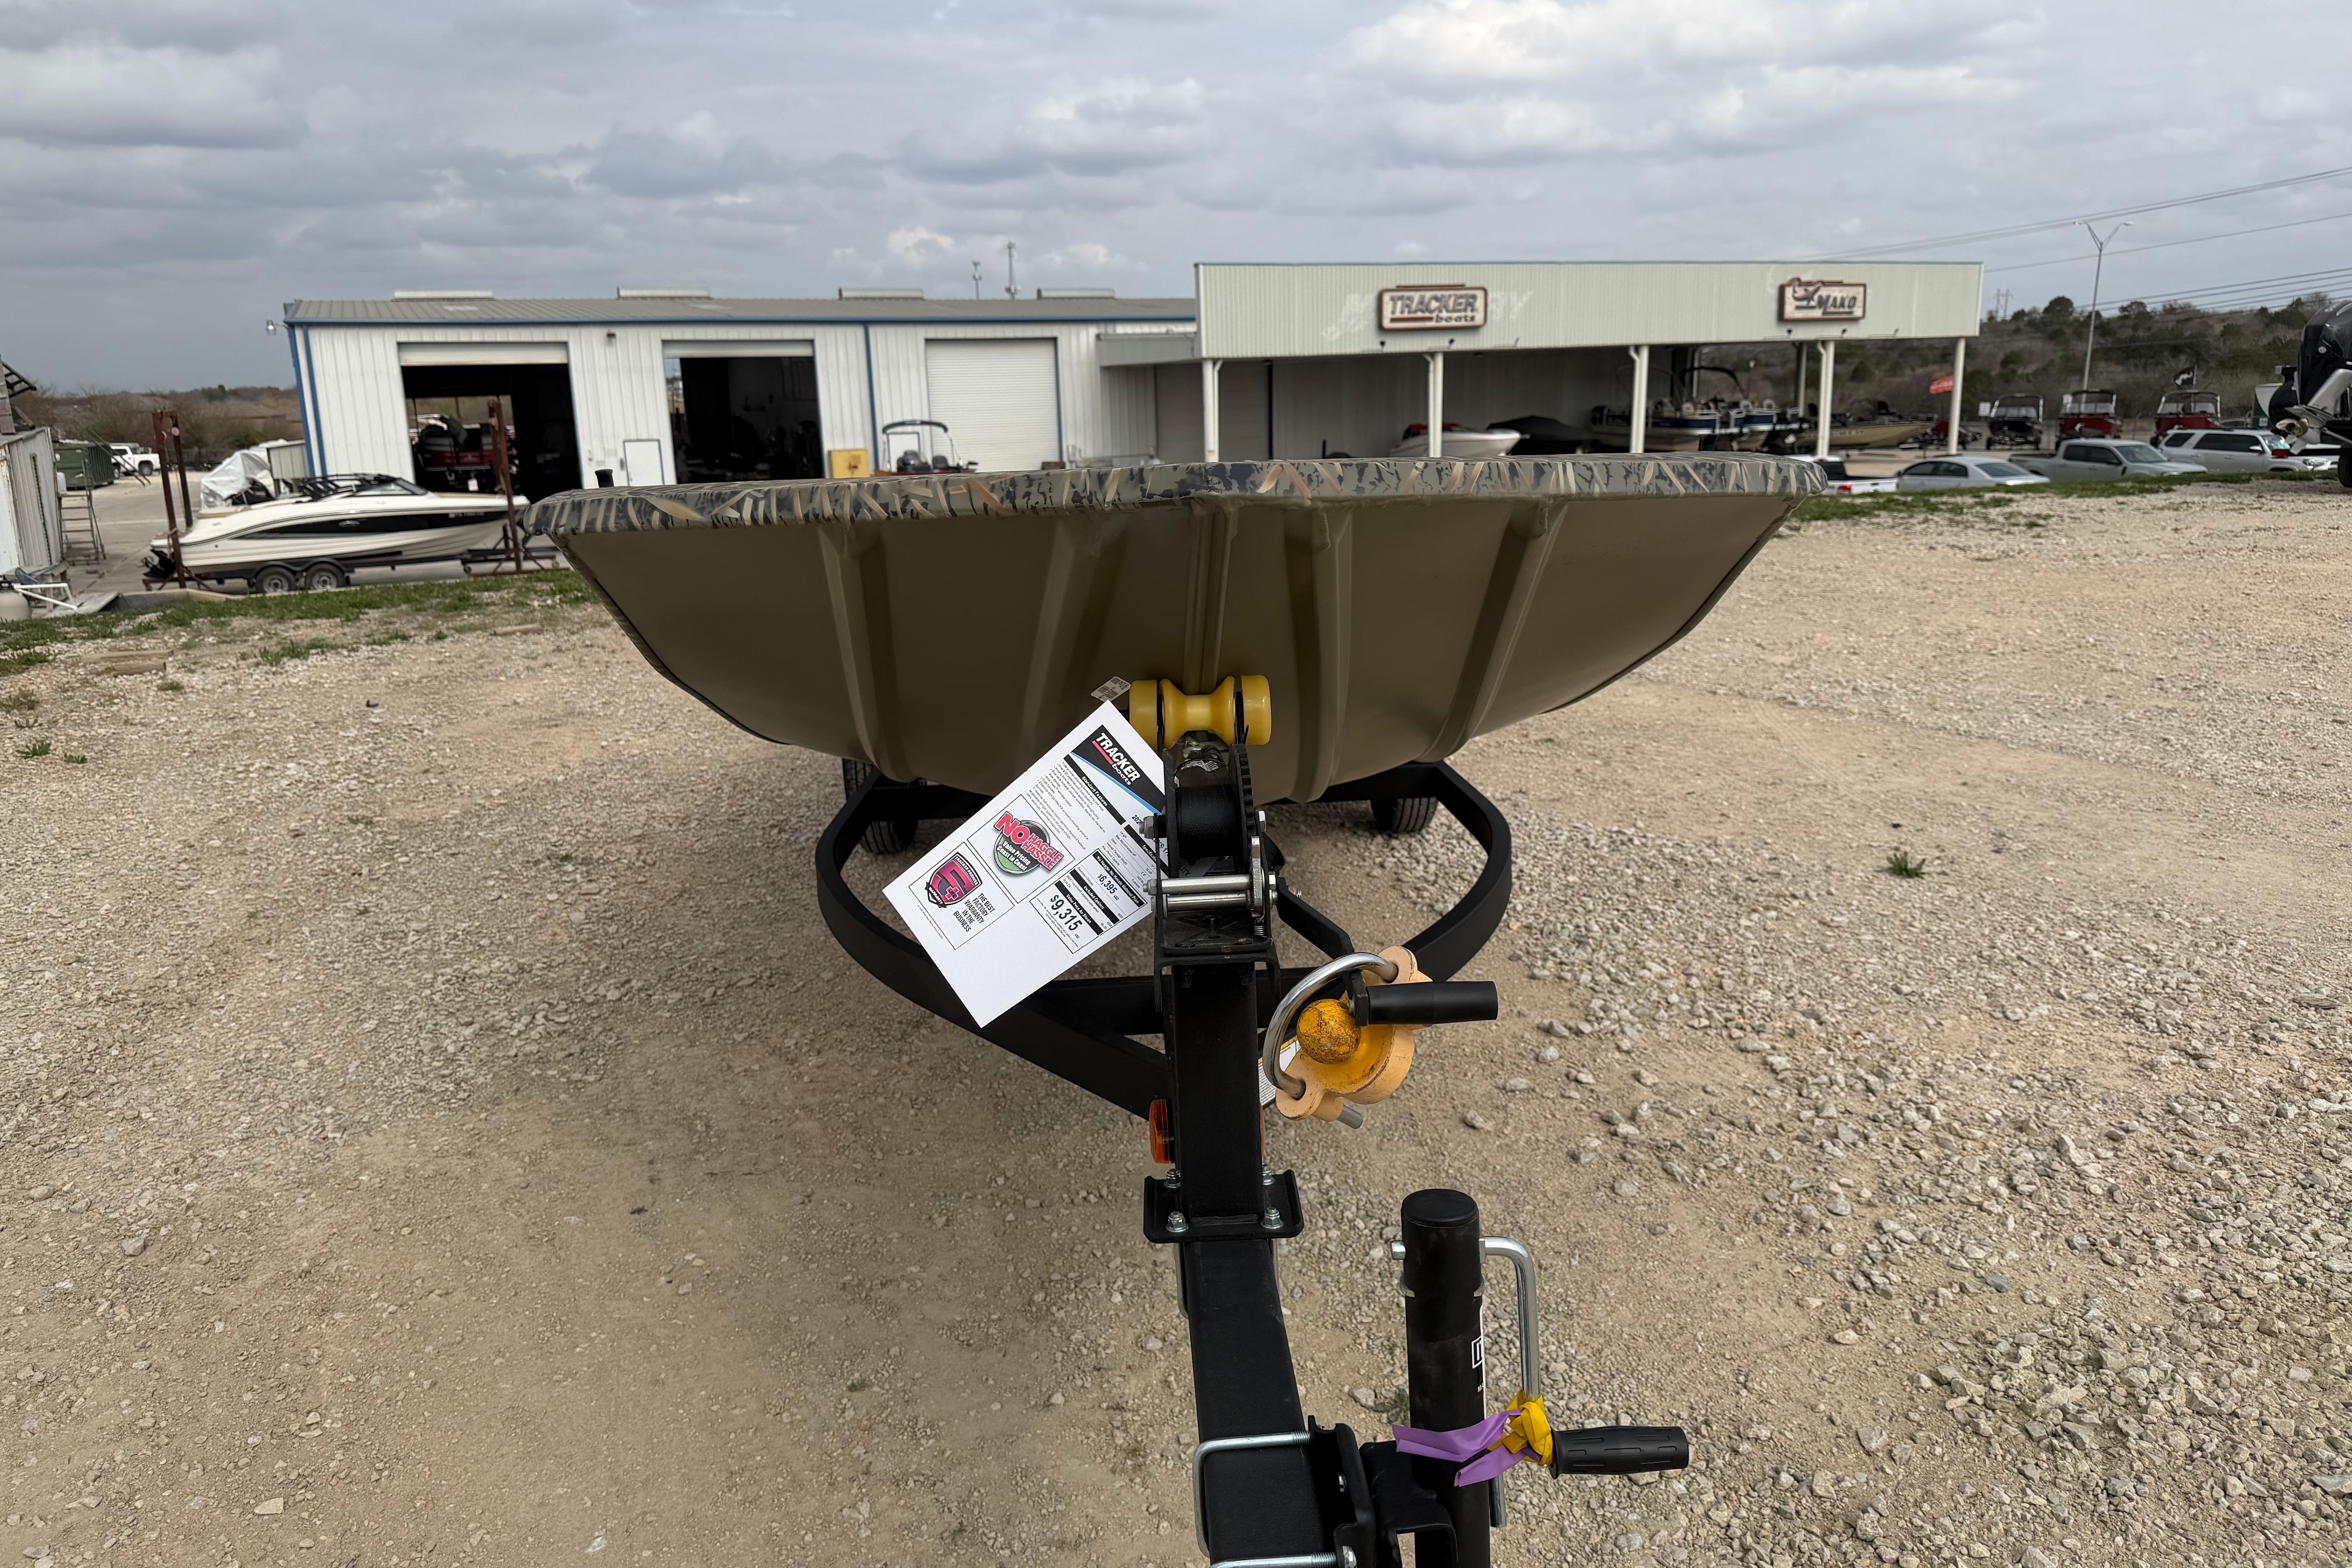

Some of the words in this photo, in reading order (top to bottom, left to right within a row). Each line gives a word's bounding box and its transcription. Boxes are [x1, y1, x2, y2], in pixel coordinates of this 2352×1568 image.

[1390, 294, 1477, 315] TRACKER
[1816, 294, 1857, 316] MAKO
[1435, 314, 1476, 323] boats
[1094, 731, 1141, 783] TRACKER
[1111, 762, 1132, 786] boats
[1081, 775, 1097, 792] Standard
[1094, 790, 1108, 806] Features
[994, 811, 1030, 844] NO
[996, 845, 1012, 859] Coast
[1013, 859, 1027, 871] Coast
[1002, 840, 1017, 854] Value
[1013, 850, 1031, 866] Pricing
[1021, 840, 1056, 869] HASSLE
[1028, 833, 1063, 862] HAGGLE
[1097, 874, 1118, 894] $6,395
[1099, 859, 1111, 872] Haggle
[1131, 895, 1140, 904] Price
[971, 897, 989, 917] FACTORY
[978, 892, 987, 903] THE
[983, 900, 995, 914] BEST
[1065, 893, 1075, 903] Value
[1072, 901, 1081, 911] Price
[1082, 912, 1092, 924] Shown
[1083, 884, 1096, 899] Included
[1093, 896, 1105, 910] Options
[952, 910, 972, 932] BUSINESS
[964, 899, 985, 924] WARRANTY
[965, 914, 975, 924] THE
[1050, 894, 1083, 931] $9,315
